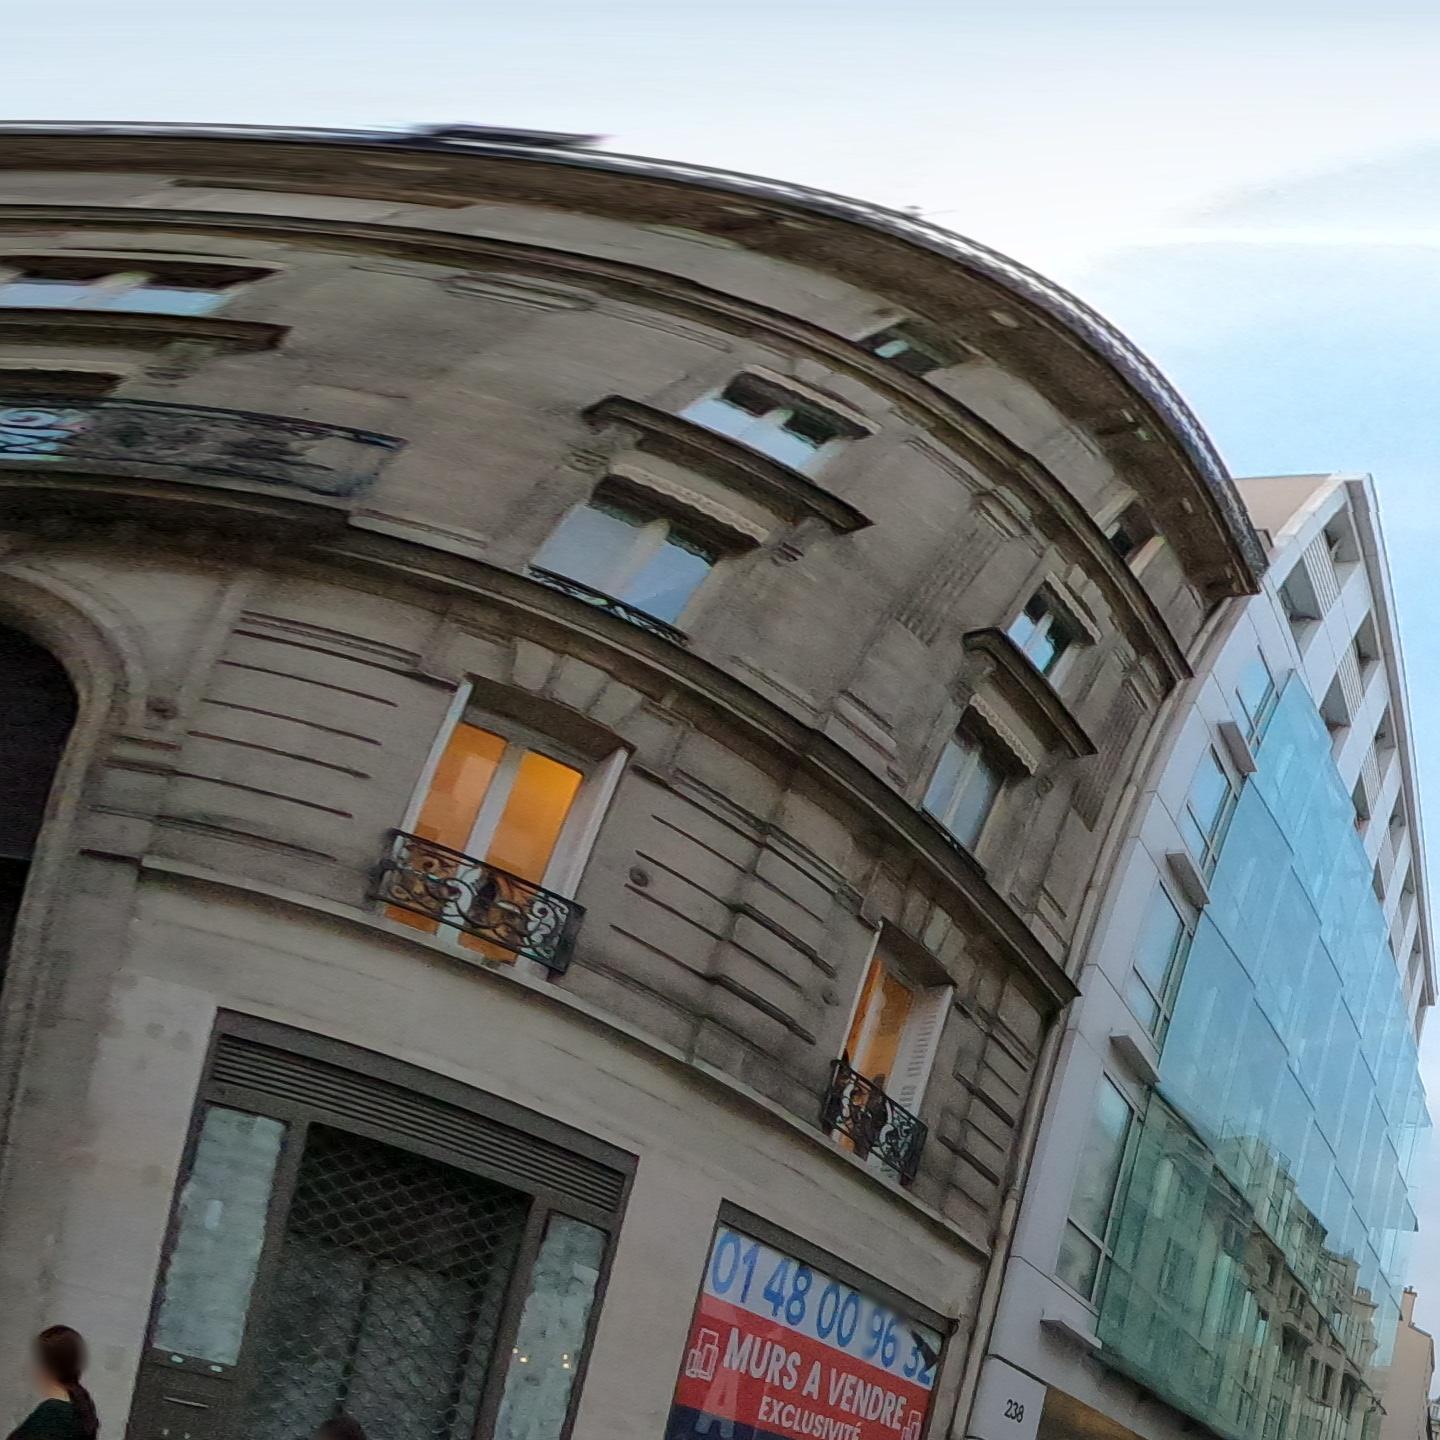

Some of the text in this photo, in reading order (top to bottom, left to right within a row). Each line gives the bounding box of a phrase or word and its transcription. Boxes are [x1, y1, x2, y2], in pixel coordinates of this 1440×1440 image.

[711, 1231, 761, 1303] 01
[763, 1257, 813, 1326] 48
[816, 1282, 861, 1348] 00
[723, 1327, 908, 1430] MURS A VENDRE
[1004, 1398, 1025, 1423] 238
